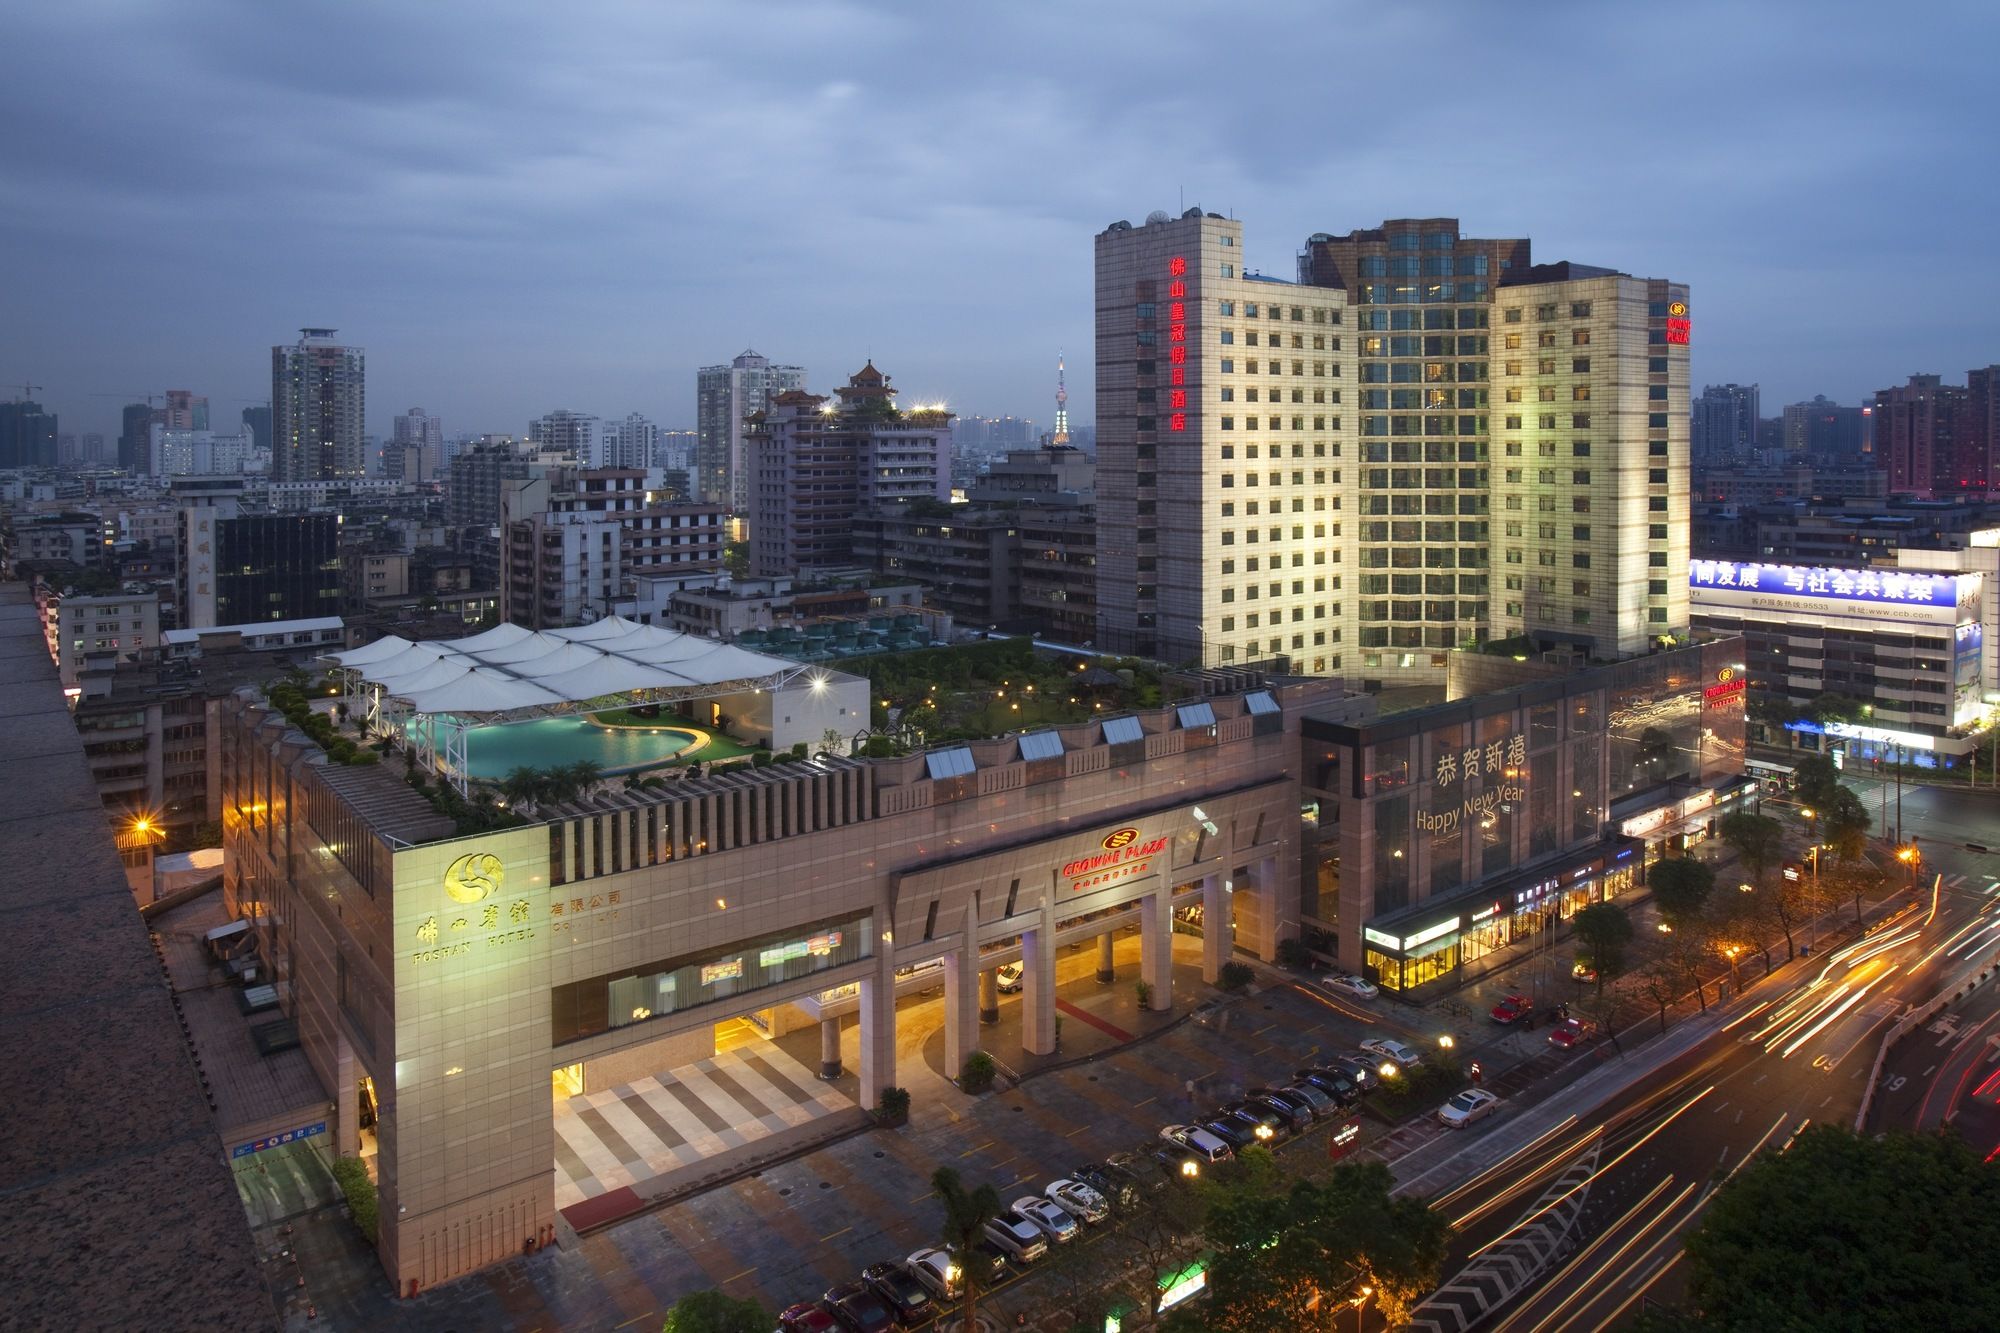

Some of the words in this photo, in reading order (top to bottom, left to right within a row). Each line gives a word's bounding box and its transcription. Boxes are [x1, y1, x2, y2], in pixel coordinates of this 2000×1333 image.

[1169, 256, 1186, 432] 佛山皇冠假日酒店
[1667, 331, 1689, 344] PLAZA
[1689, 564, 1760, 588] 同发展
[1784, 571, 1933, 601] 与社会共繁荣
[1437, 734, 1526, 787] 恭贺新禧
[1416, 808, 1460, 836] Happy
[1463, 792, 1494, 818] New
[1497, 785, 1525, 803] Year
[1063, 850, 1120, 877] CROWNE
[1124, 837, 1169, 859] PLAZA
[413, 942, 471, 966] FOSHAN
[488, 928, 535, 947] HOTEL
